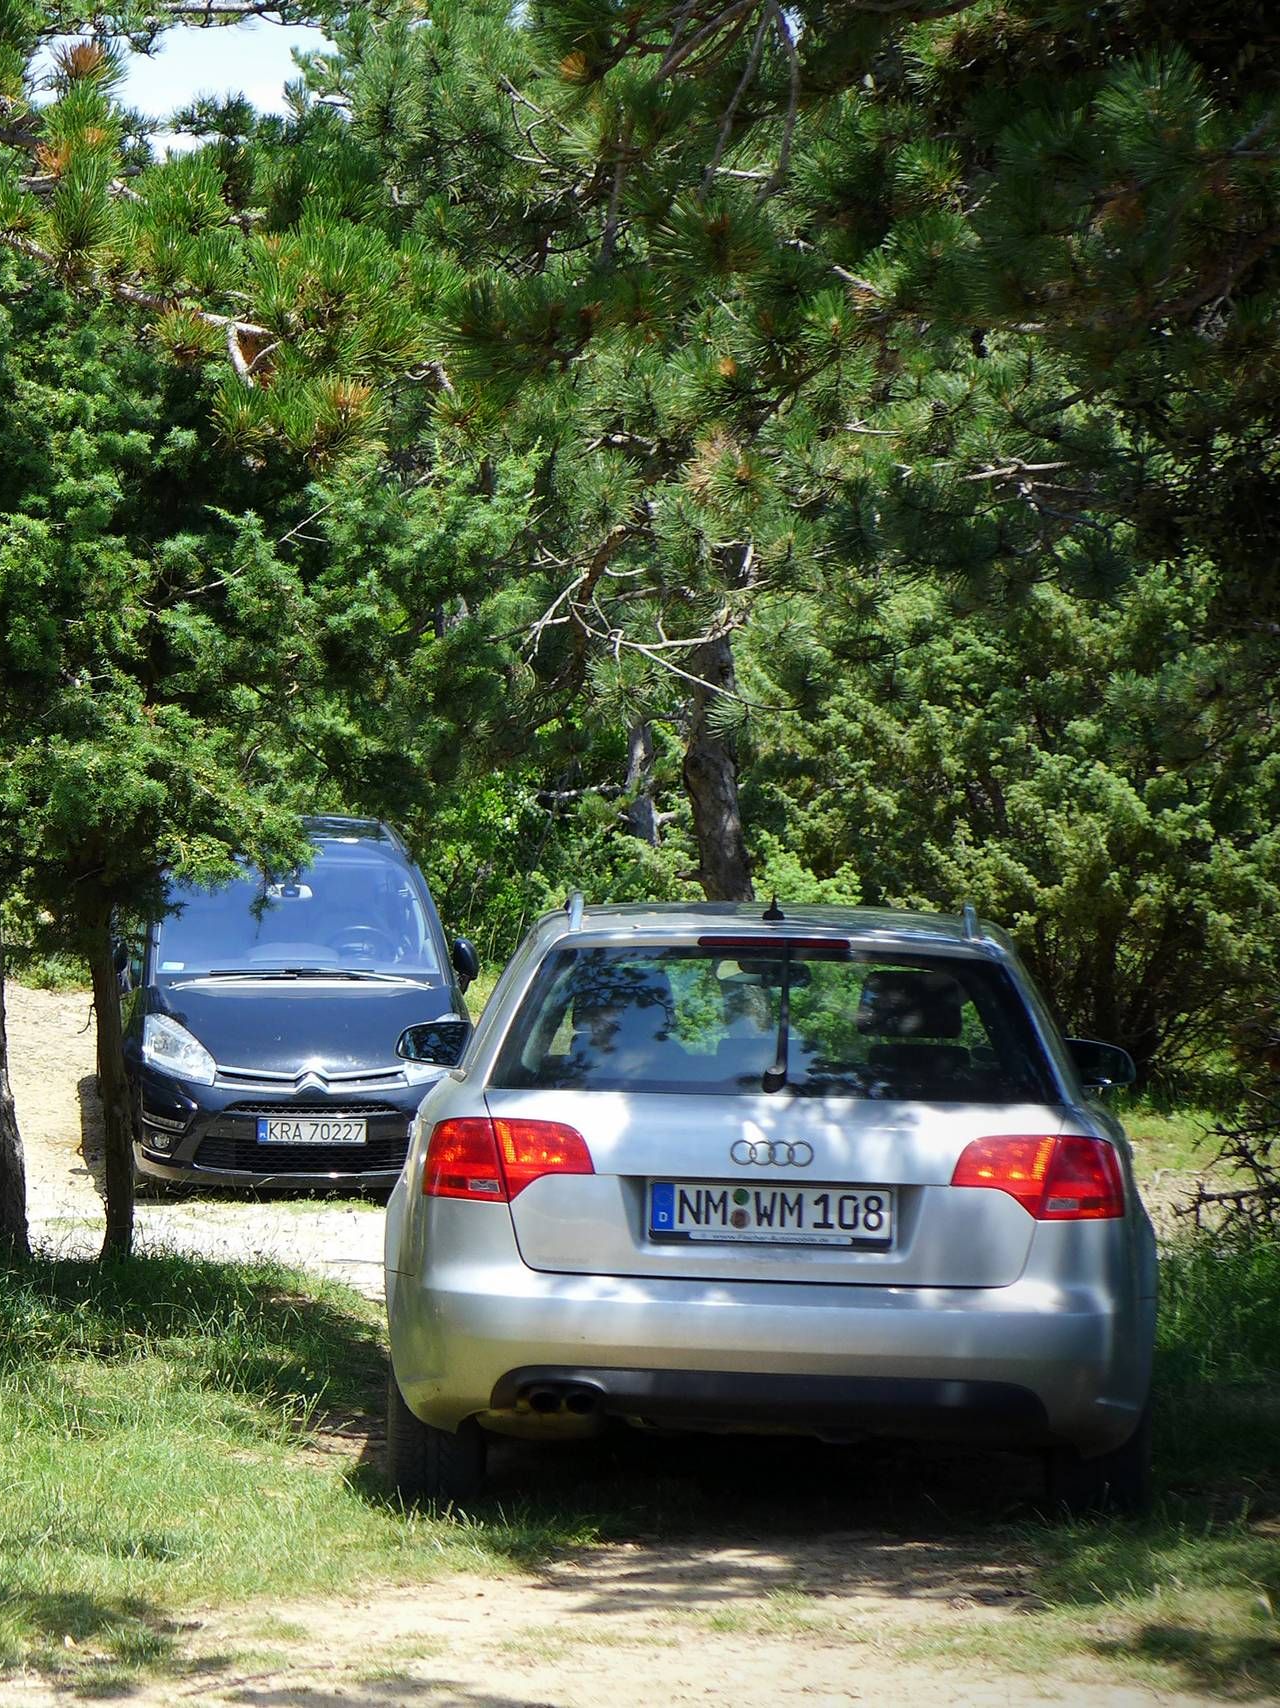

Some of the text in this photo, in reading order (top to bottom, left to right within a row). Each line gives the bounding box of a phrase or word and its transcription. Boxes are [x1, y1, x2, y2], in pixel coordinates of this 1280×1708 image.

[269, 1122, 364, 1141] KRA 70227
[658, 1212, 668, 1222] D
[678, 1189, 884, 1232] NM WM 108
